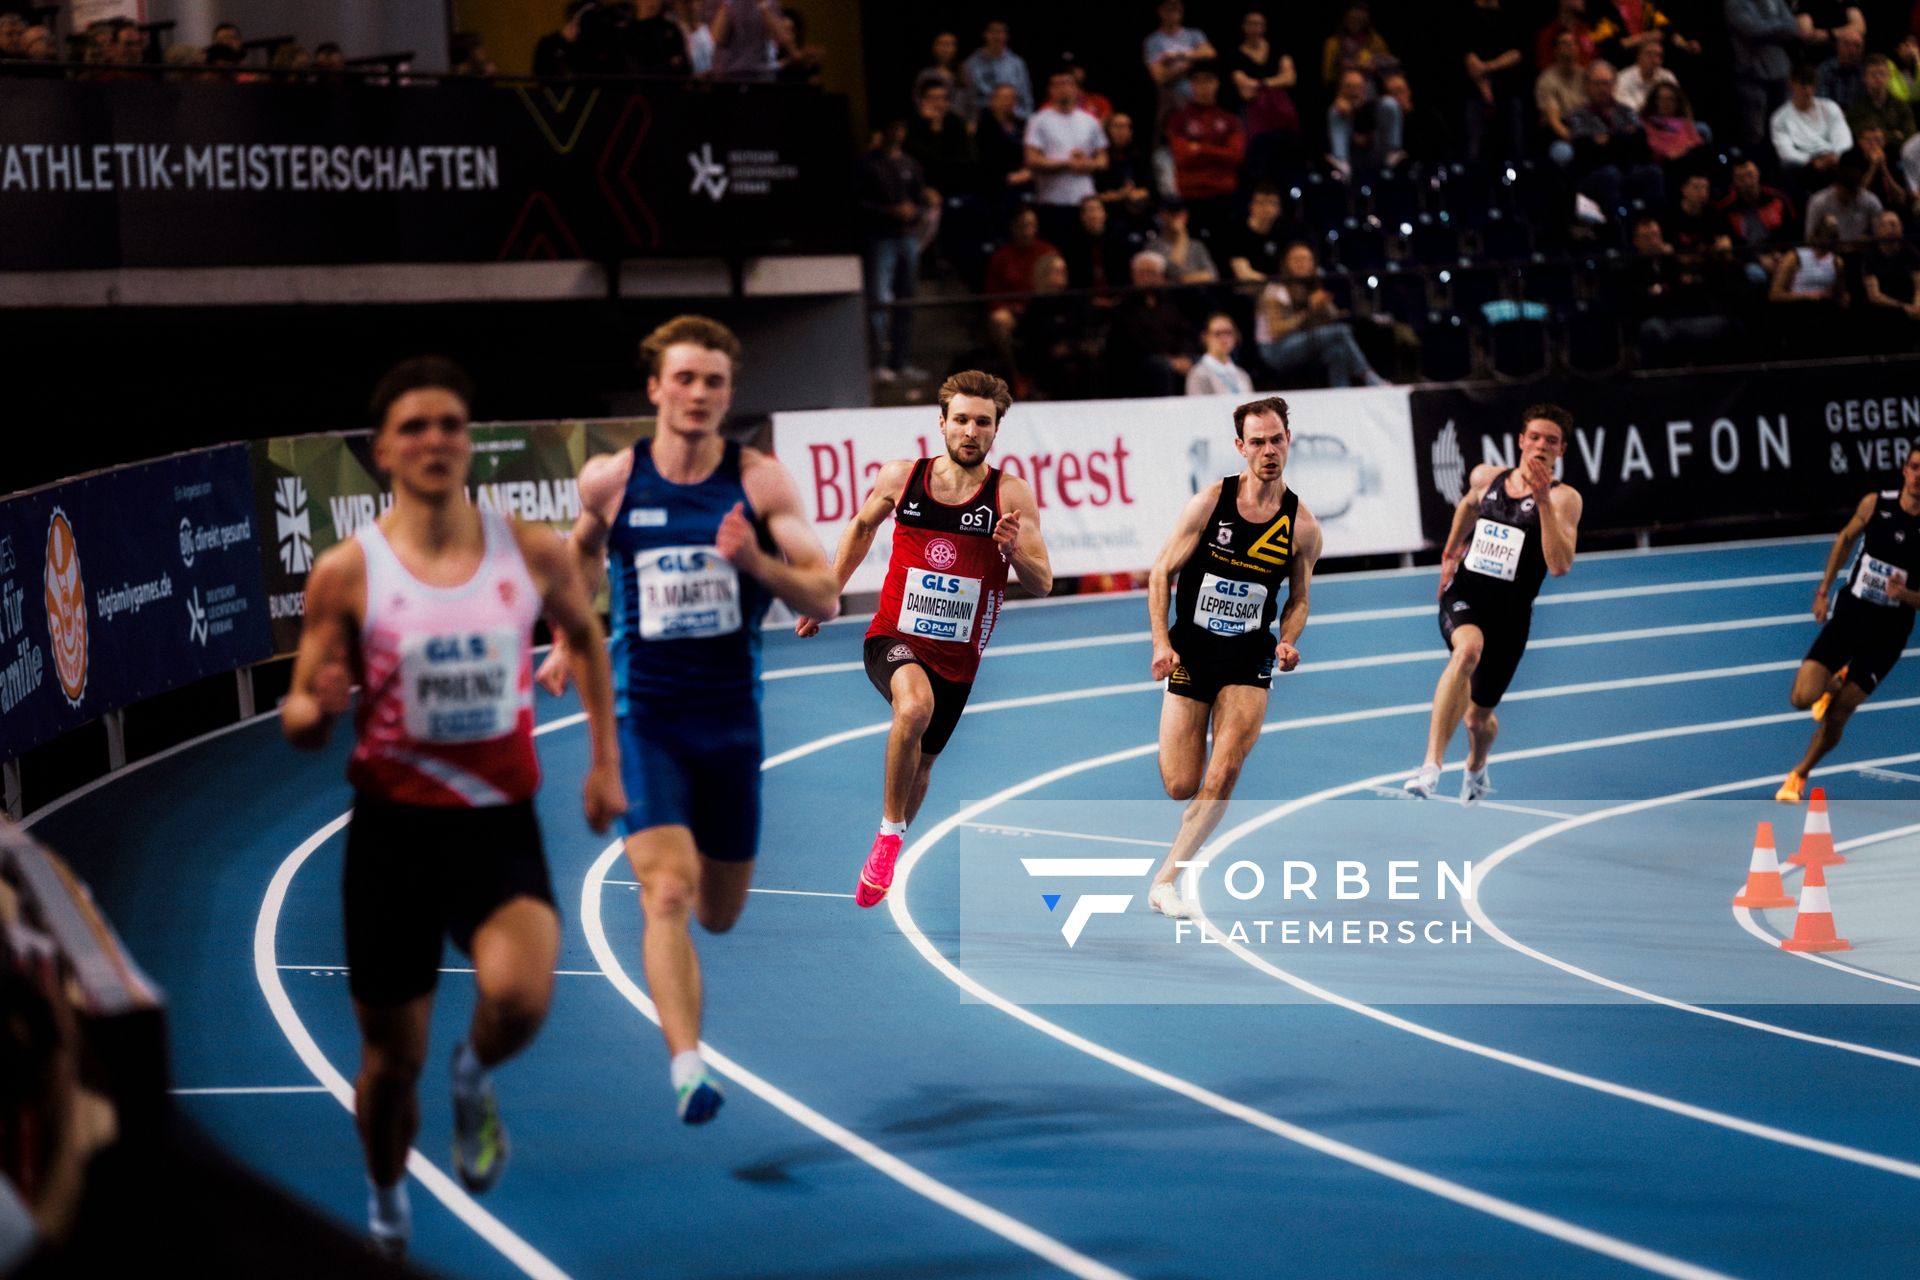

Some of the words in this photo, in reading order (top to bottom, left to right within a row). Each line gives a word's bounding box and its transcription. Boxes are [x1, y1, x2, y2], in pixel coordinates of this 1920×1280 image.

[0, 144, 498, 191] ATHLETIK-MEISTERSCHAFTEN
[1825, 396, 1920, 433] GEGEN
[1481, 414, 1792, 484] NVAFON
[1829, 441, 1848, 474] &
[1857, 436, 1920, 471] VER
[991, 436, 1134, 510] orest
[961, 512, 983, 527] OS
[1484, 524, 1510, 540] GLS
[657, 552, 707, 573] GLS
[1475, 539, 1516, 561] RUMPF
[96, 571, 173, 621] bigfamilygames.de
[921, 574, 960, 594] GLS
[1215, 580, 1250, 598] GLS
[269, 591, 305, 618] BUNDES
[906, 592, 973, 620] DAMMERMANN
[1200, 595, 1261, 620] LEPPELSACK
[931, 623, 955, 633] PLAN
[1222, 622, 1244, 631] PLAN
